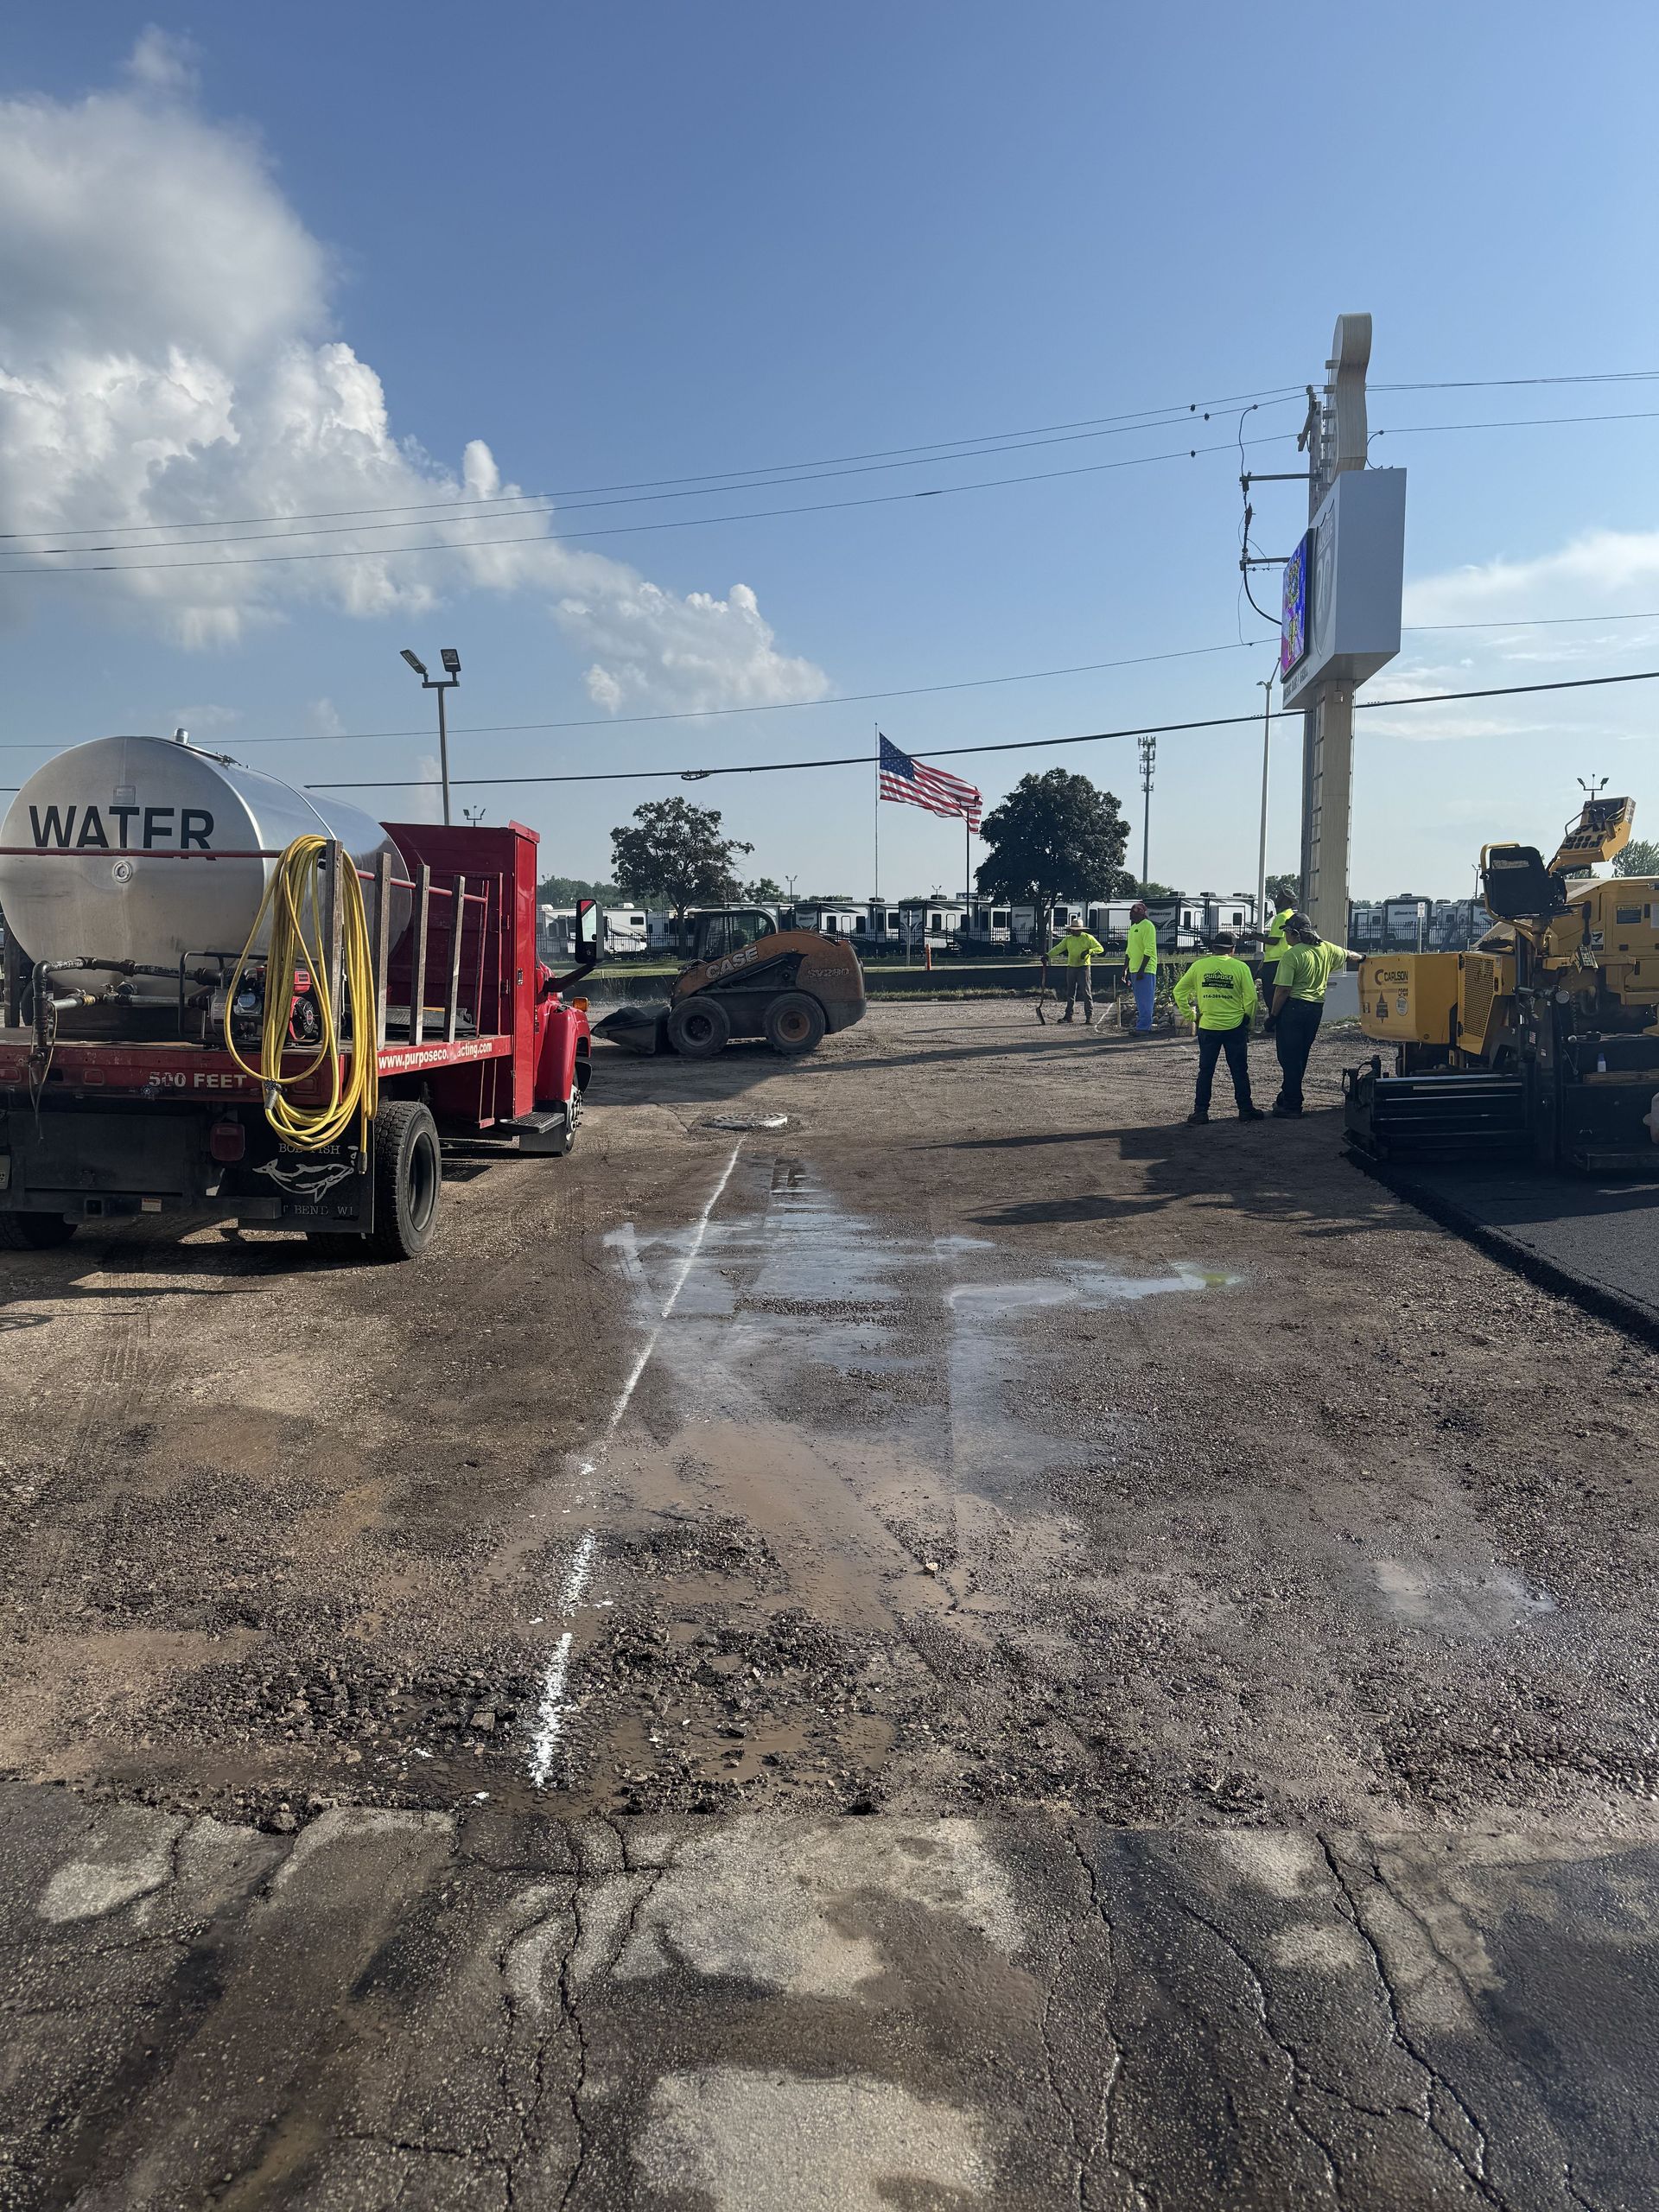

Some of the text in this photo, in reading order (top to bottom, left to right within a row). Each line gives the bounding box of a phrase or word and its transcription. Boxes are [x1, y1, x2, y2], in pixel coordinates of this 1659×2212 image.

[29, 805, 216, 861] WATER
[705, 946, 759, 979] CASE
[1384, 970, 1408, 982] CARLSON
[378, 1041, 493, 1070] www.purposecoacting.com
[194, 1072, 247, 1089] FEET
[295, 1205, 328, 1215] BEND
